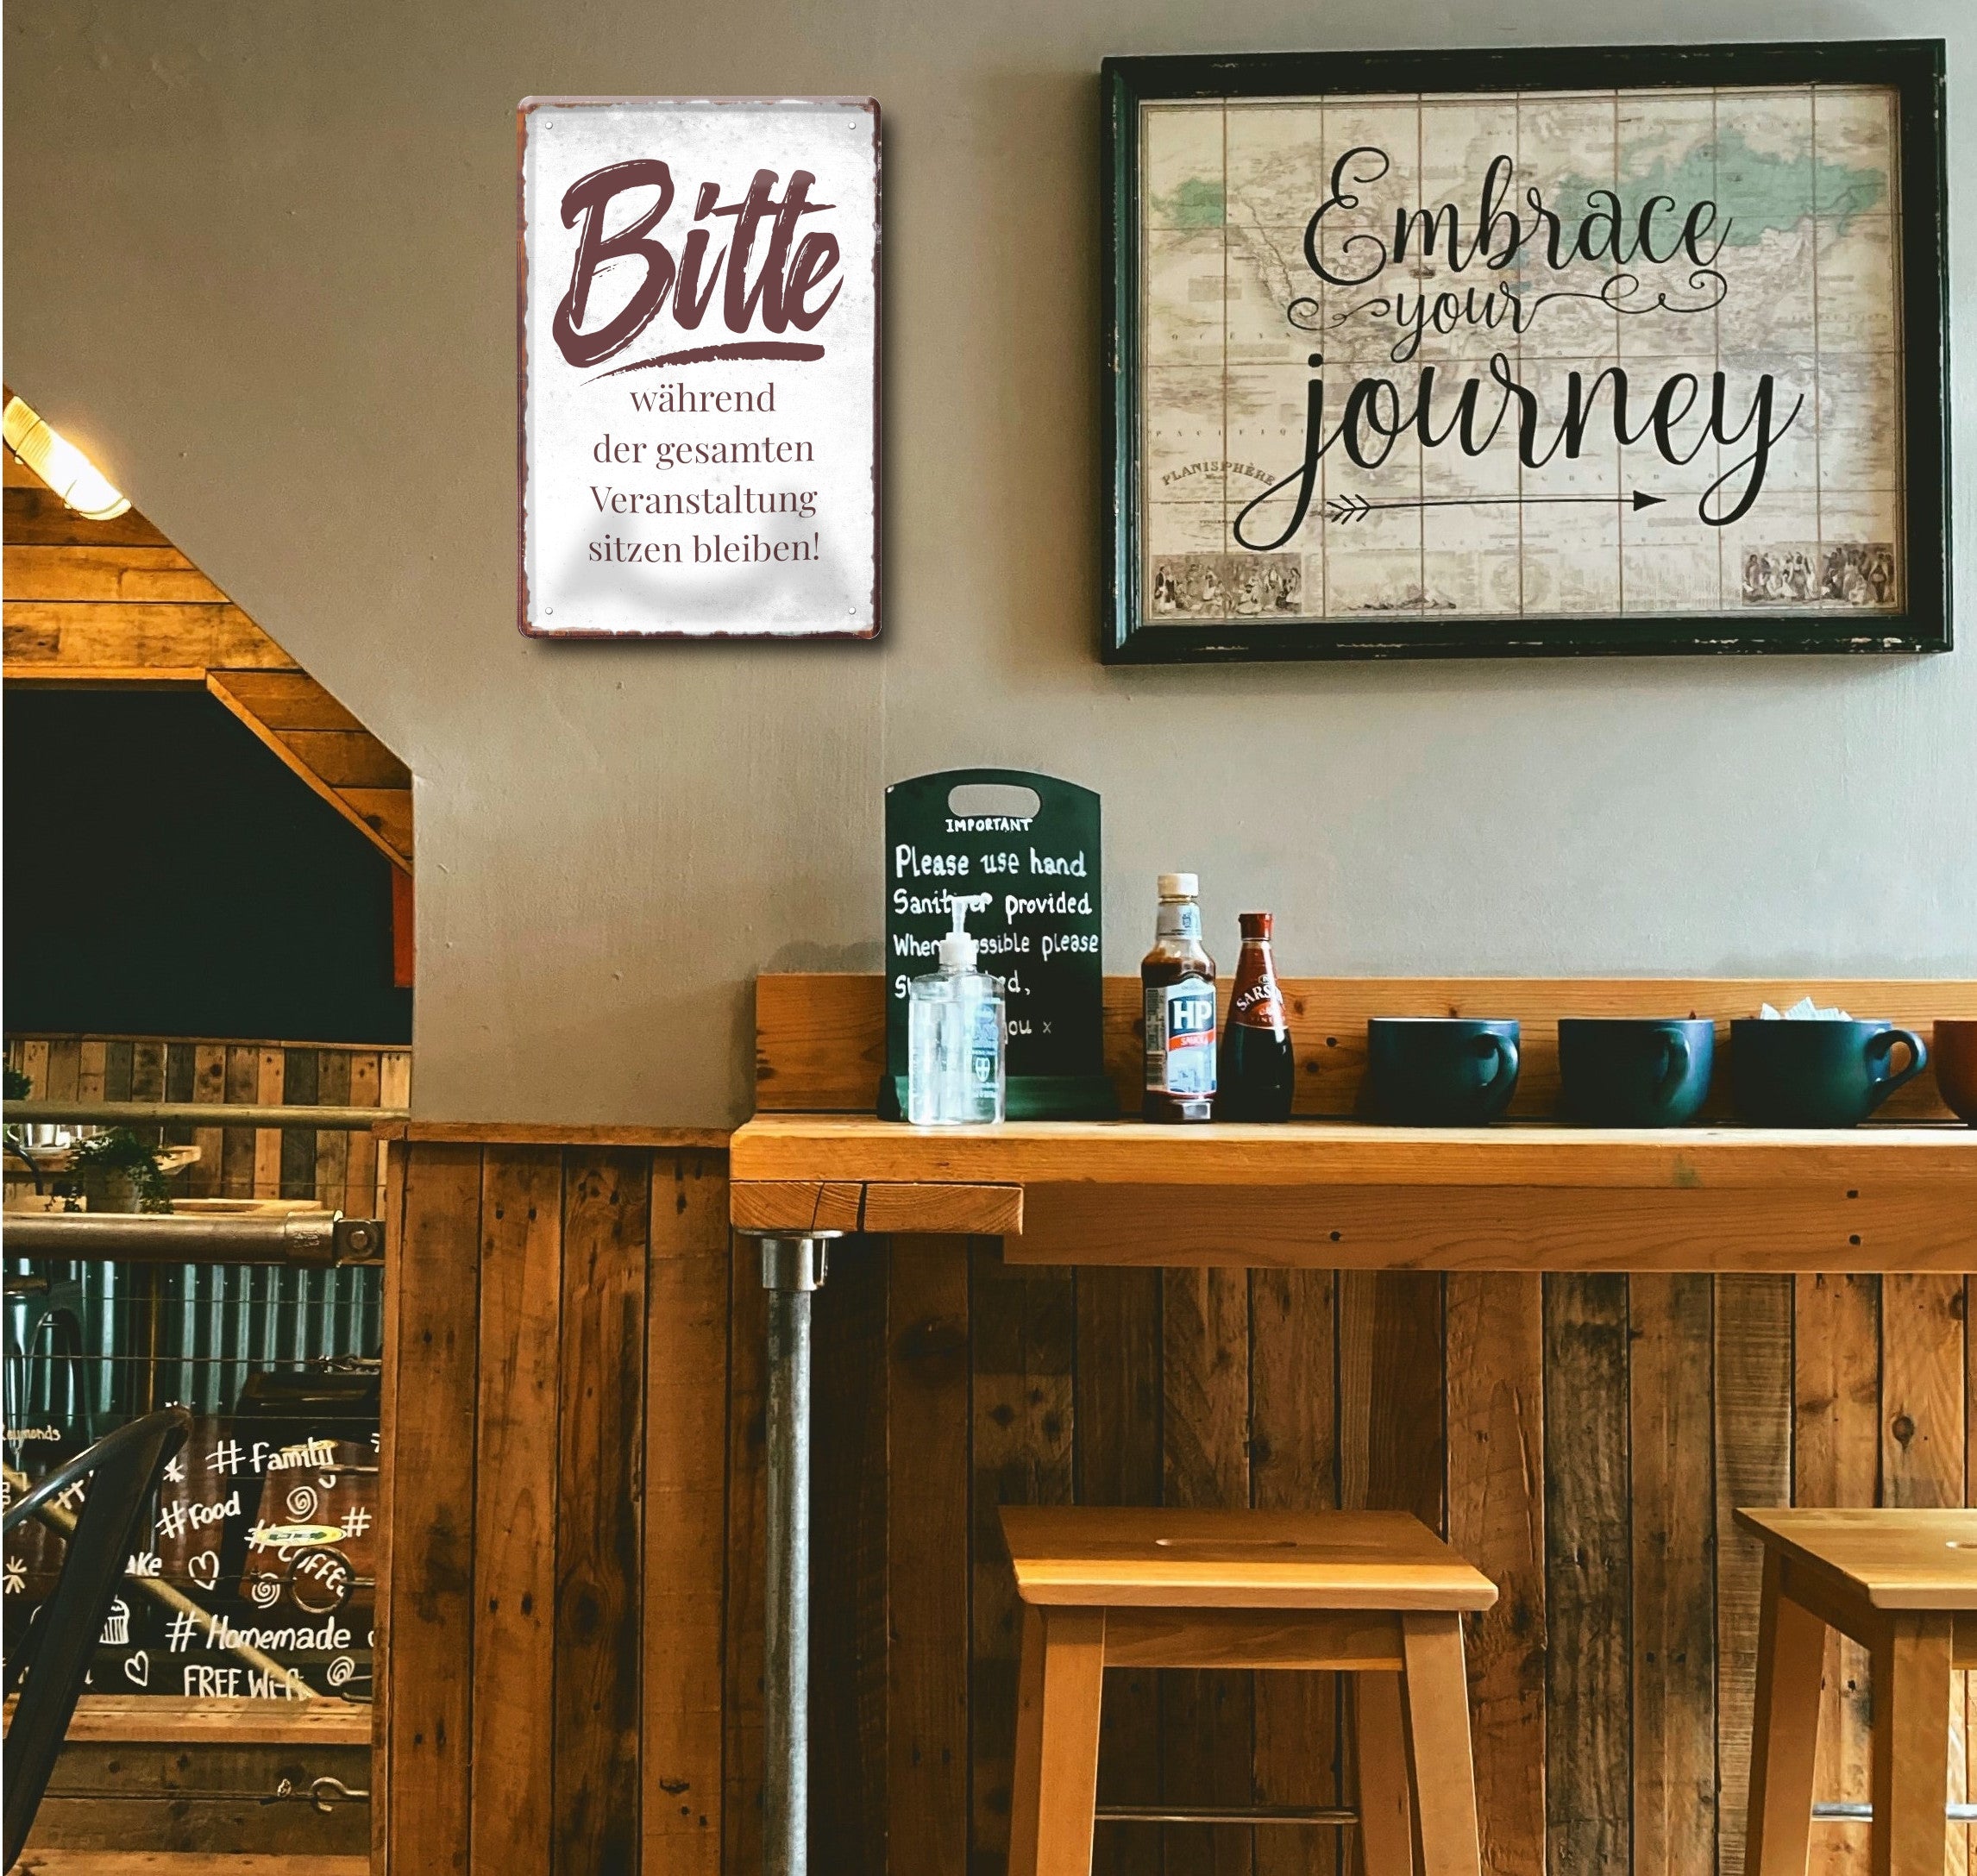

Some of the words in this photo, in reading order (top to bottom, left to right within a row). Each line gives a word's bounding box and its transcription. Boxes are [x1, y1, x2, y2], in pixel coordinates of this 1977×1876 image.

[1304, 147, 1732, 285] Embrace
[553, 160, 844, 368] Bitte
[630, 383, 775, 412] während
[593, 434, 647, 463] der
[656, 437, 815, 470] gesamten
[1234, 352, 1803, 550] journey
[589, 485, 818, 518] Veranstaltung
[588, 534, 681, 563] sitzen
[693, 531, 819, 563] bleiben!
[945, 818, 1033, 832] IMPORTANT
[895, 844, 970, 878] Please
[980, 852, 1020, 875] use
[1029, 846, 1088, 878] hand
[893, 888, 993, 914] Saniter
[1005, 891, 1093, 925] provided
[977, 932, 1031, 955] ssible
[1041, 932, 1099, 962] please
[1173, 1001, 1212, 1029] HP
[184, 1665, 242, 1698] FREE
